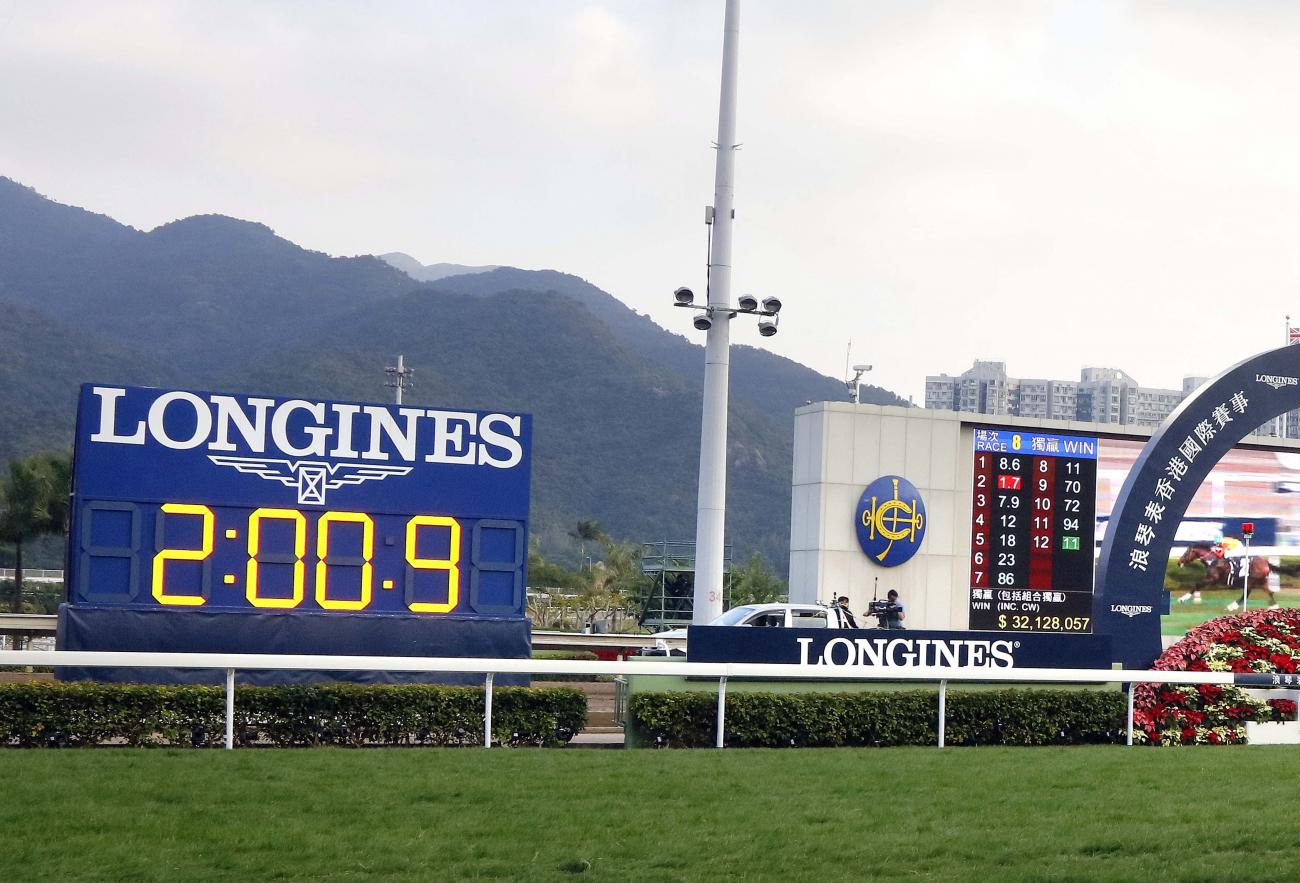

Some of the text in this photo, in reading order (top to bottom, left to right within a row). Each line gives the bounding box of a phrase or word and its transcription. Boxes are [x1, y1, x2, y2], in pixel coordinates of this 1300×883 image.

[1256, 374, 1298, 385] LONGINES
[90, 386, 523, 469] LONGINES
[977, 430, 998, 442] 場次
[977, 441, 1007, 452] RACE
[1012, 435, 1021, 450] 8
[1063, 440, 1094, 455] WIN
[979, 456, 1080, 475] 1 8.6 8 11
[977, 475, 1081, 494] 2 1.7 9 70
[1129, 390, 1249, 572] 浪琴表香港國際賽事
[977, 494, 1080, 513] 3 7.9 10 72
[976, 514, 1079, 531] 4 12 11 94
[975, 533, 1078, 549] 5 18 12 11
[152, 503, 461, 613] 2:00.9
[974, 552, 1015, 566] 6 23
[974, 571, 1014, 585] 7 86
[972, 601, 1040, 613] WIN (INC. CW)
[1110, 604, 1152, 613] LONGINES
[998, 614, 1090, 631] $ 32,128,057
